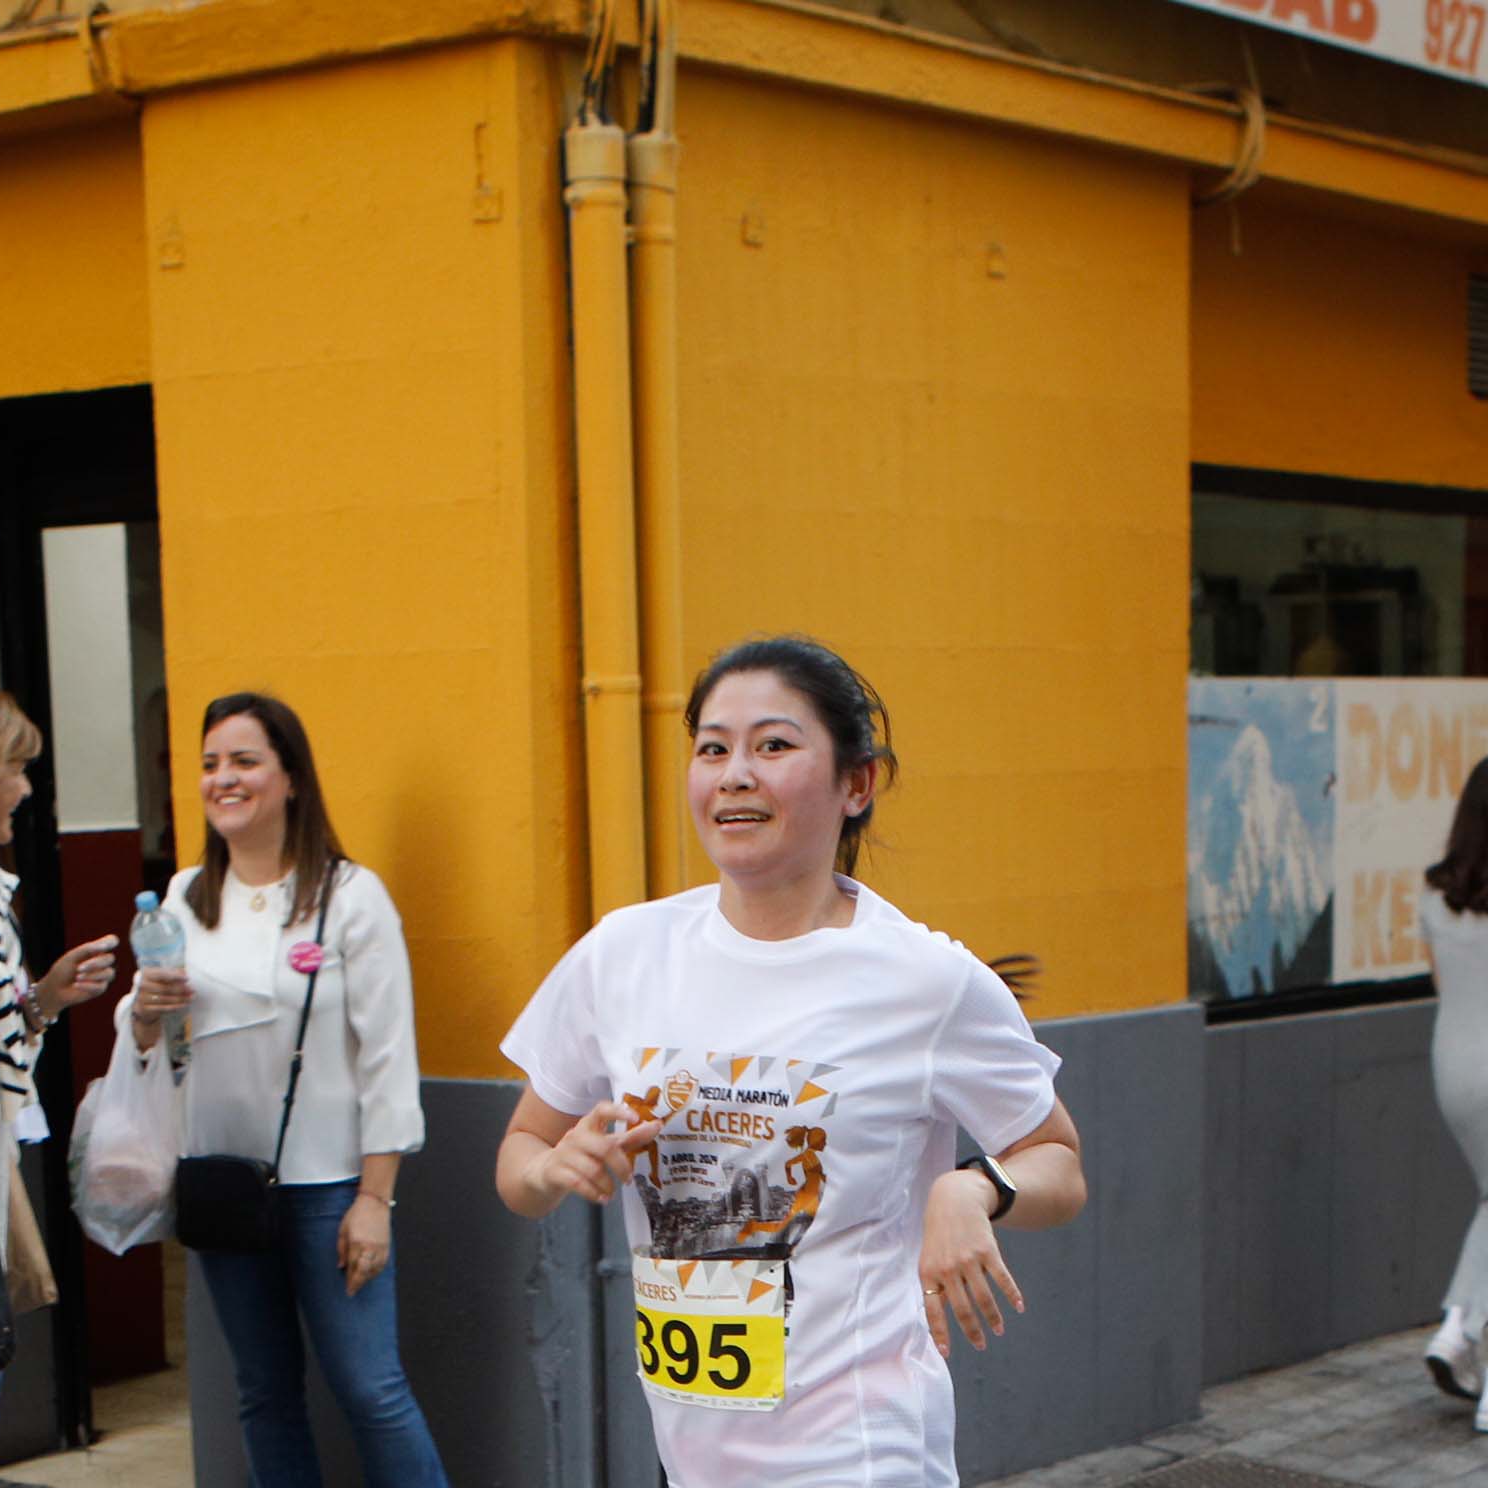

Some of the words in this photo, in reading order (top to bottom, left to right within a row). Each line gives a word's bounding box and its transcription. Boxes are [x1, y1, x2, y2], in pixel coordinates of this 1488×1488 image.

[1424, 0, 1487, 75] 927
[685, 1103, 776, 1141] CÁCERES
[697, 1085, 732, 1102] MEDIA
[736, 1088, 790, 1108] MARATÓN
[637, 1310, 751, 1390] 395
